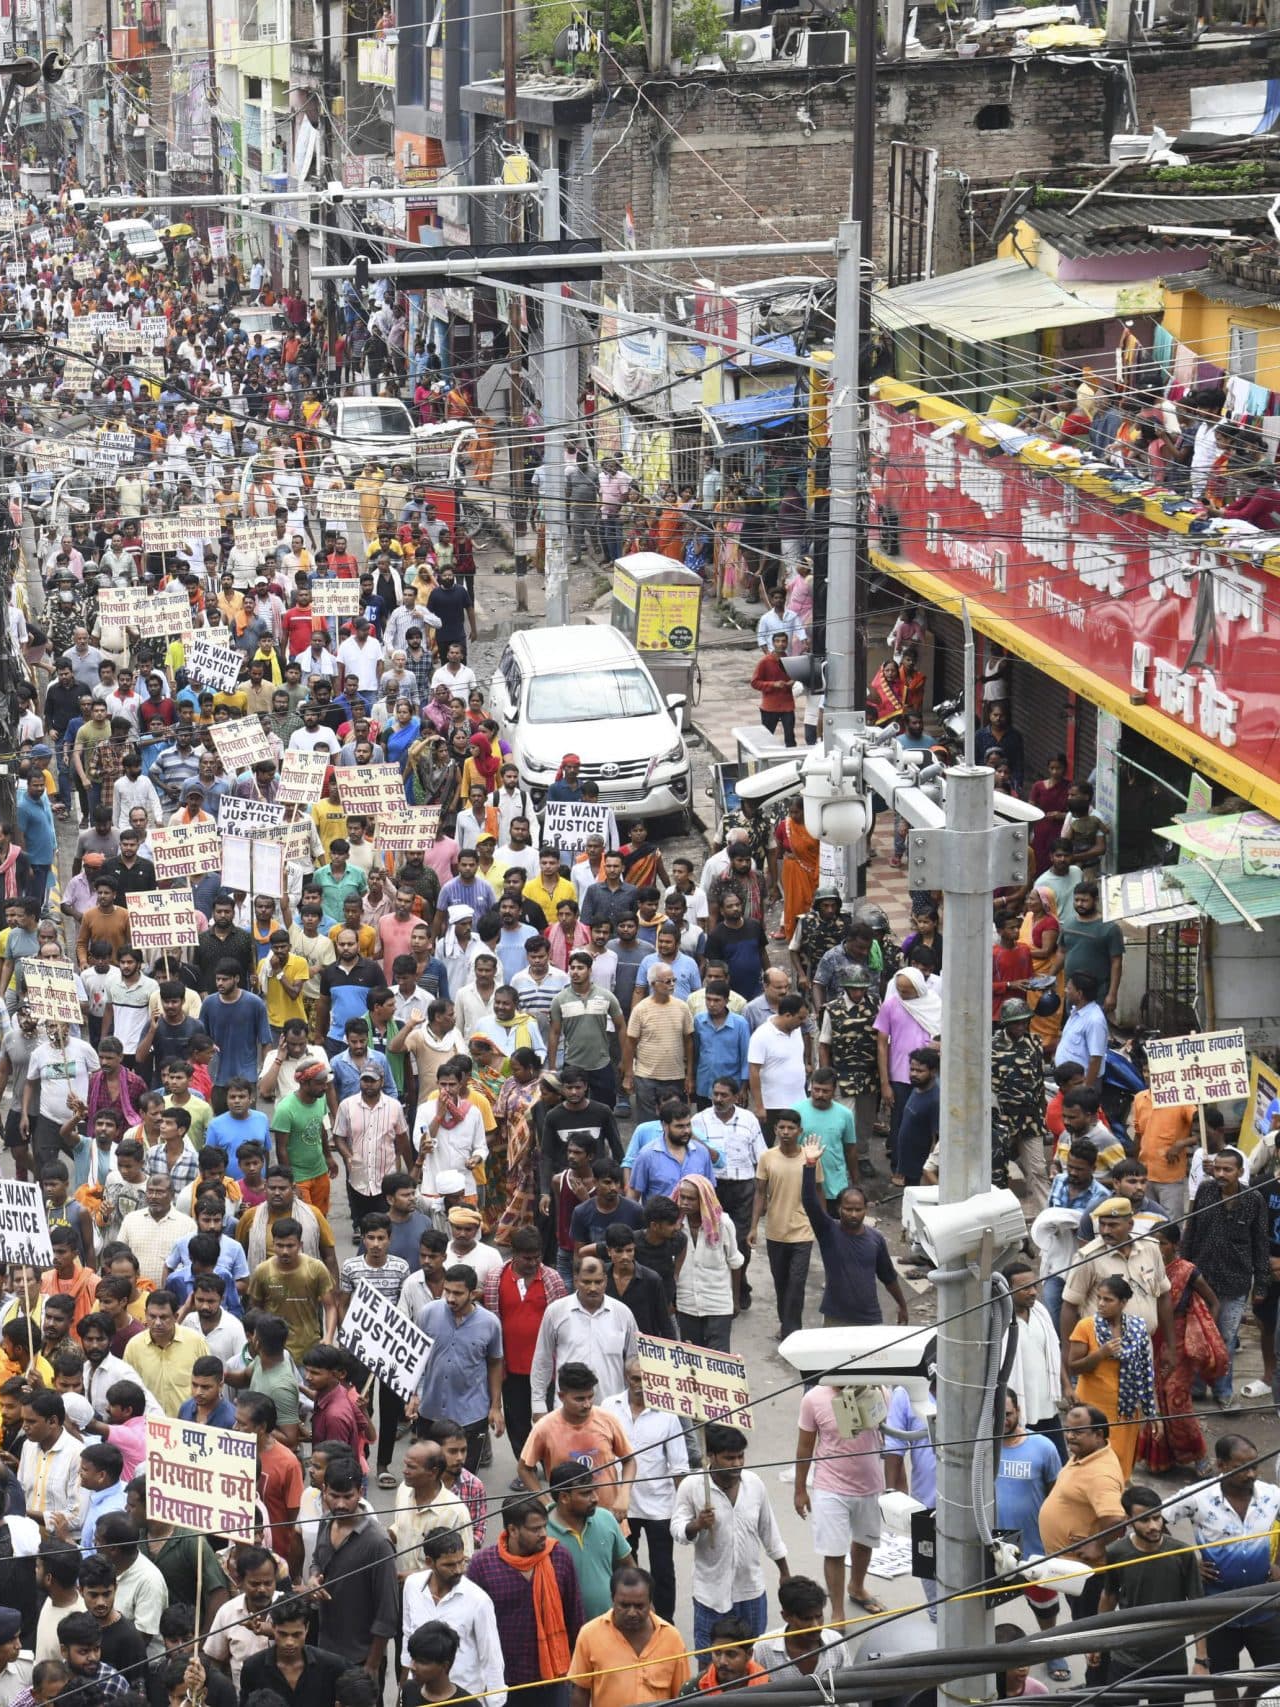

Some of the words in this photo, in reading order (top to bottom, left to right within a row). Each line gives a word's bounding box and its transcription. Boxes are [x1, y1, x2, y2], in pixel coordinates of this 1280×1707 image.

[113, 434, 134, 442] WANT
[194, 641, 209, 655] WE
[212, 647, 243, 665] WANT
[193, 656, 236, 678] JUSTICE
[339, 784, 381, 798] गिरफ्तार
[383, 780, 404, 795] करो
[221, 796, 240, 809] WE
[245, 798, 283, 815] WANT
[342, 800, 384, 814] गिरफ्तार
[386, 796, 407, 811] करो
[547, 803, 566, 816] WE
[571, 804, 608, 818] WANT
[223, 809, 278, 824] JUSTICE
[549, 819, 604, 833] JUSTICE
[154, 844, 194, 861] गिरफ्तार
[198, 838, 218, 853] करो
[155, 862, 197, 878] गिरफ्तार
[201, 857, 219, 870] करो
[130, 912, 170, 928] गिरफ्तार
[173, 908, 194, 925] करो
[132, 932, 172, 948] गिरफ्तार
[176, 928, 196, 945] करो
[1180, 1063, 1227, 1084] अभियुक्त
[1230, 1058, 1246, 1074] को
[1234, 1077, 1247, 1094] दो
[4, 1183, 37, 1207] WANT
[358, 1281, 382, 1315] WE
[384, 1305, 431, 1356] WANT
[352, 1308, 418, 1375] JUSTICE
[675, 1376, 729, 1403] अभियुक्त
[732, 1387, 749, 1405] को
[737, 1408, 753, 1429] दो
[216, 1432, 257, 1460] गोरख
[148, 1451, 214, 1494] गिरफ्तार
[219, 1469, 255, 1503] करो
[1003, 1461, 1031, 1478] HIGH
[148, 1487, 214, 1530] गिरफ्तार
[219, 1506, 253, 1540] करो
